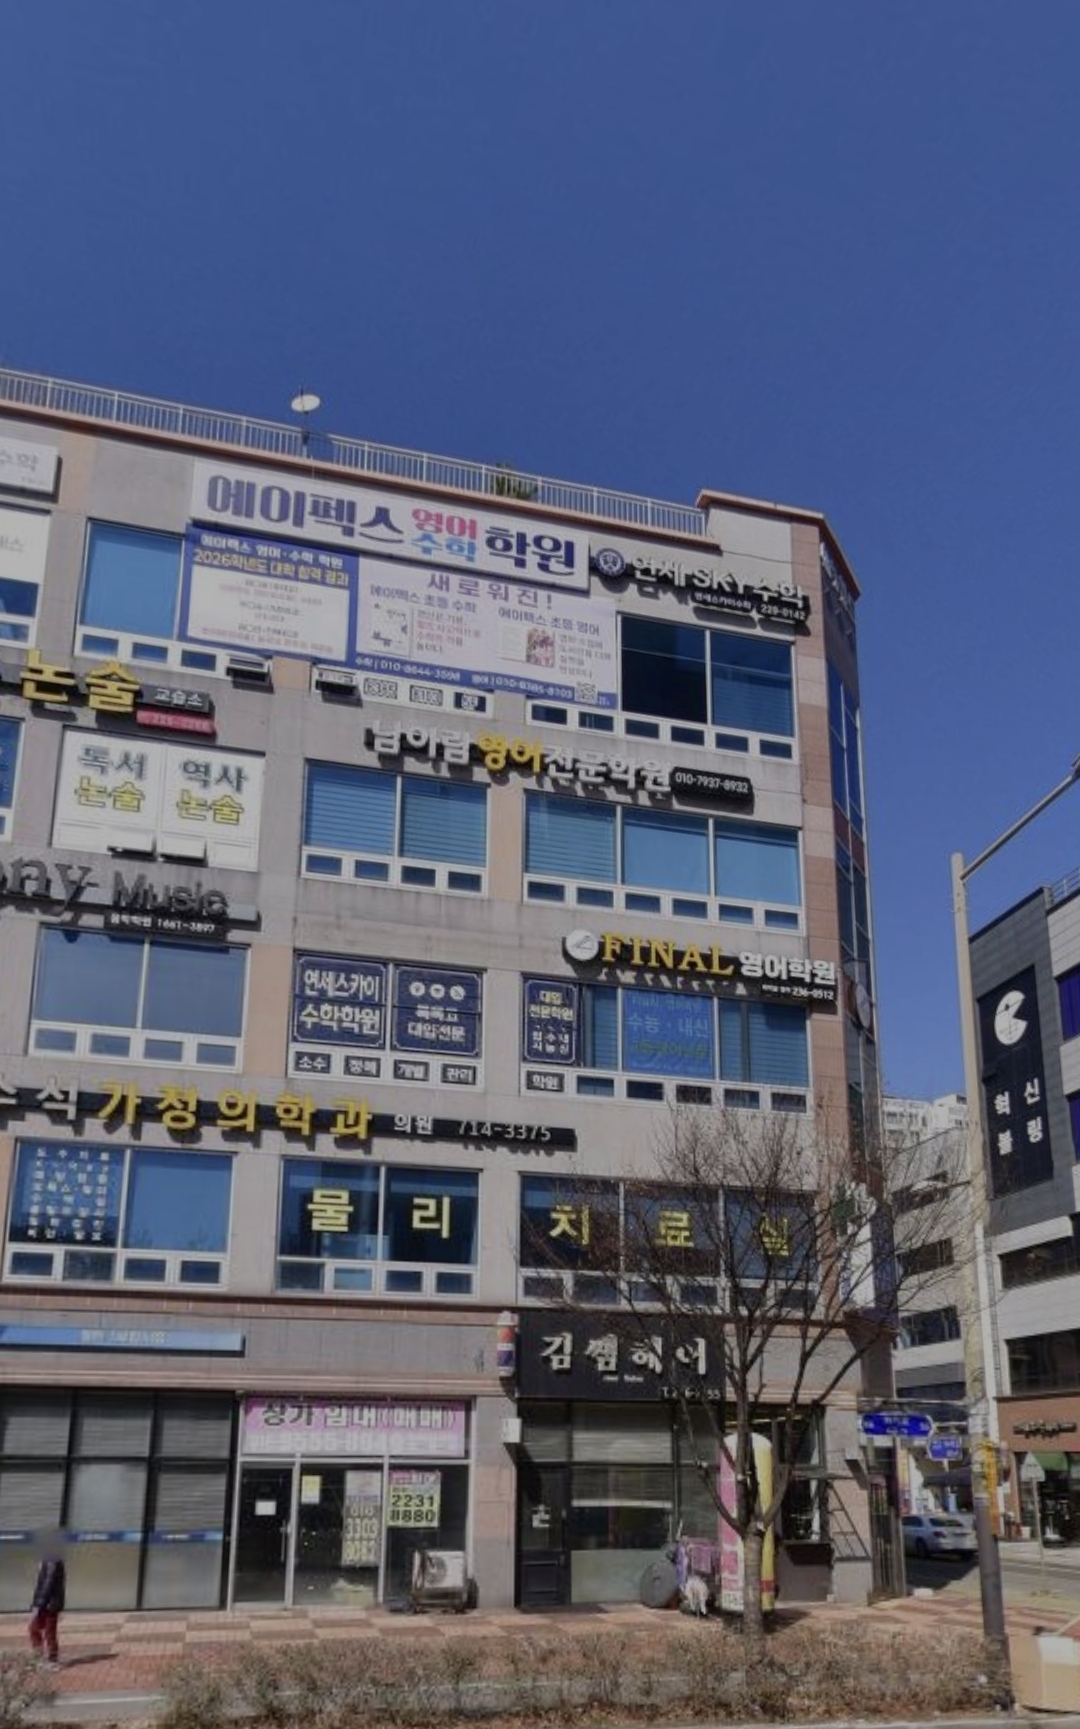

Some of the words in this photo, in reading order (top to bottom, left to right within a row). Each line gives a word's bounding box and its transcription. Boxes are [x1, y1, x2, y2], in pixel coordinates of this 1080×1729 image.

[207, 474, 404, 544] 에이펙스
[412, 508, 477, 540] 영어
[411, 532, 477, 563] 수학
[485, 526, 575, 576] 학원
[269, 561, 295, 580] 대학
[692, 565, 751, 595] SKY
[752, 578, 805, 609] 수학
[452, 598, 477, 613] 수학
[577, 621, 600, 636] 영어
[20, 648, 141, 713] 논술
[154, 687, 203, 706] 교습소
[79, 747, 149, 780] 독서
[181, 759, 247, 793] 역사
[75, 775, 145, 813] 논술
[177, 788, 245, 826] 논술
[600, 932, 735, 976] FINAL
[739, 951, 837, 986] 영어학원
[303, 968, 380, 1002] 연세스카이
[301, 1003, 380, 1035] 수학학원
[299, 1055, 327, 1070] 소수
[393, 1113, 434, 1136] 의원
[458, 1119, 552, 1142] 714-3375
[263, 1403, 314, 1427] 상가
[391, 1494, 435, 1508] 2231
